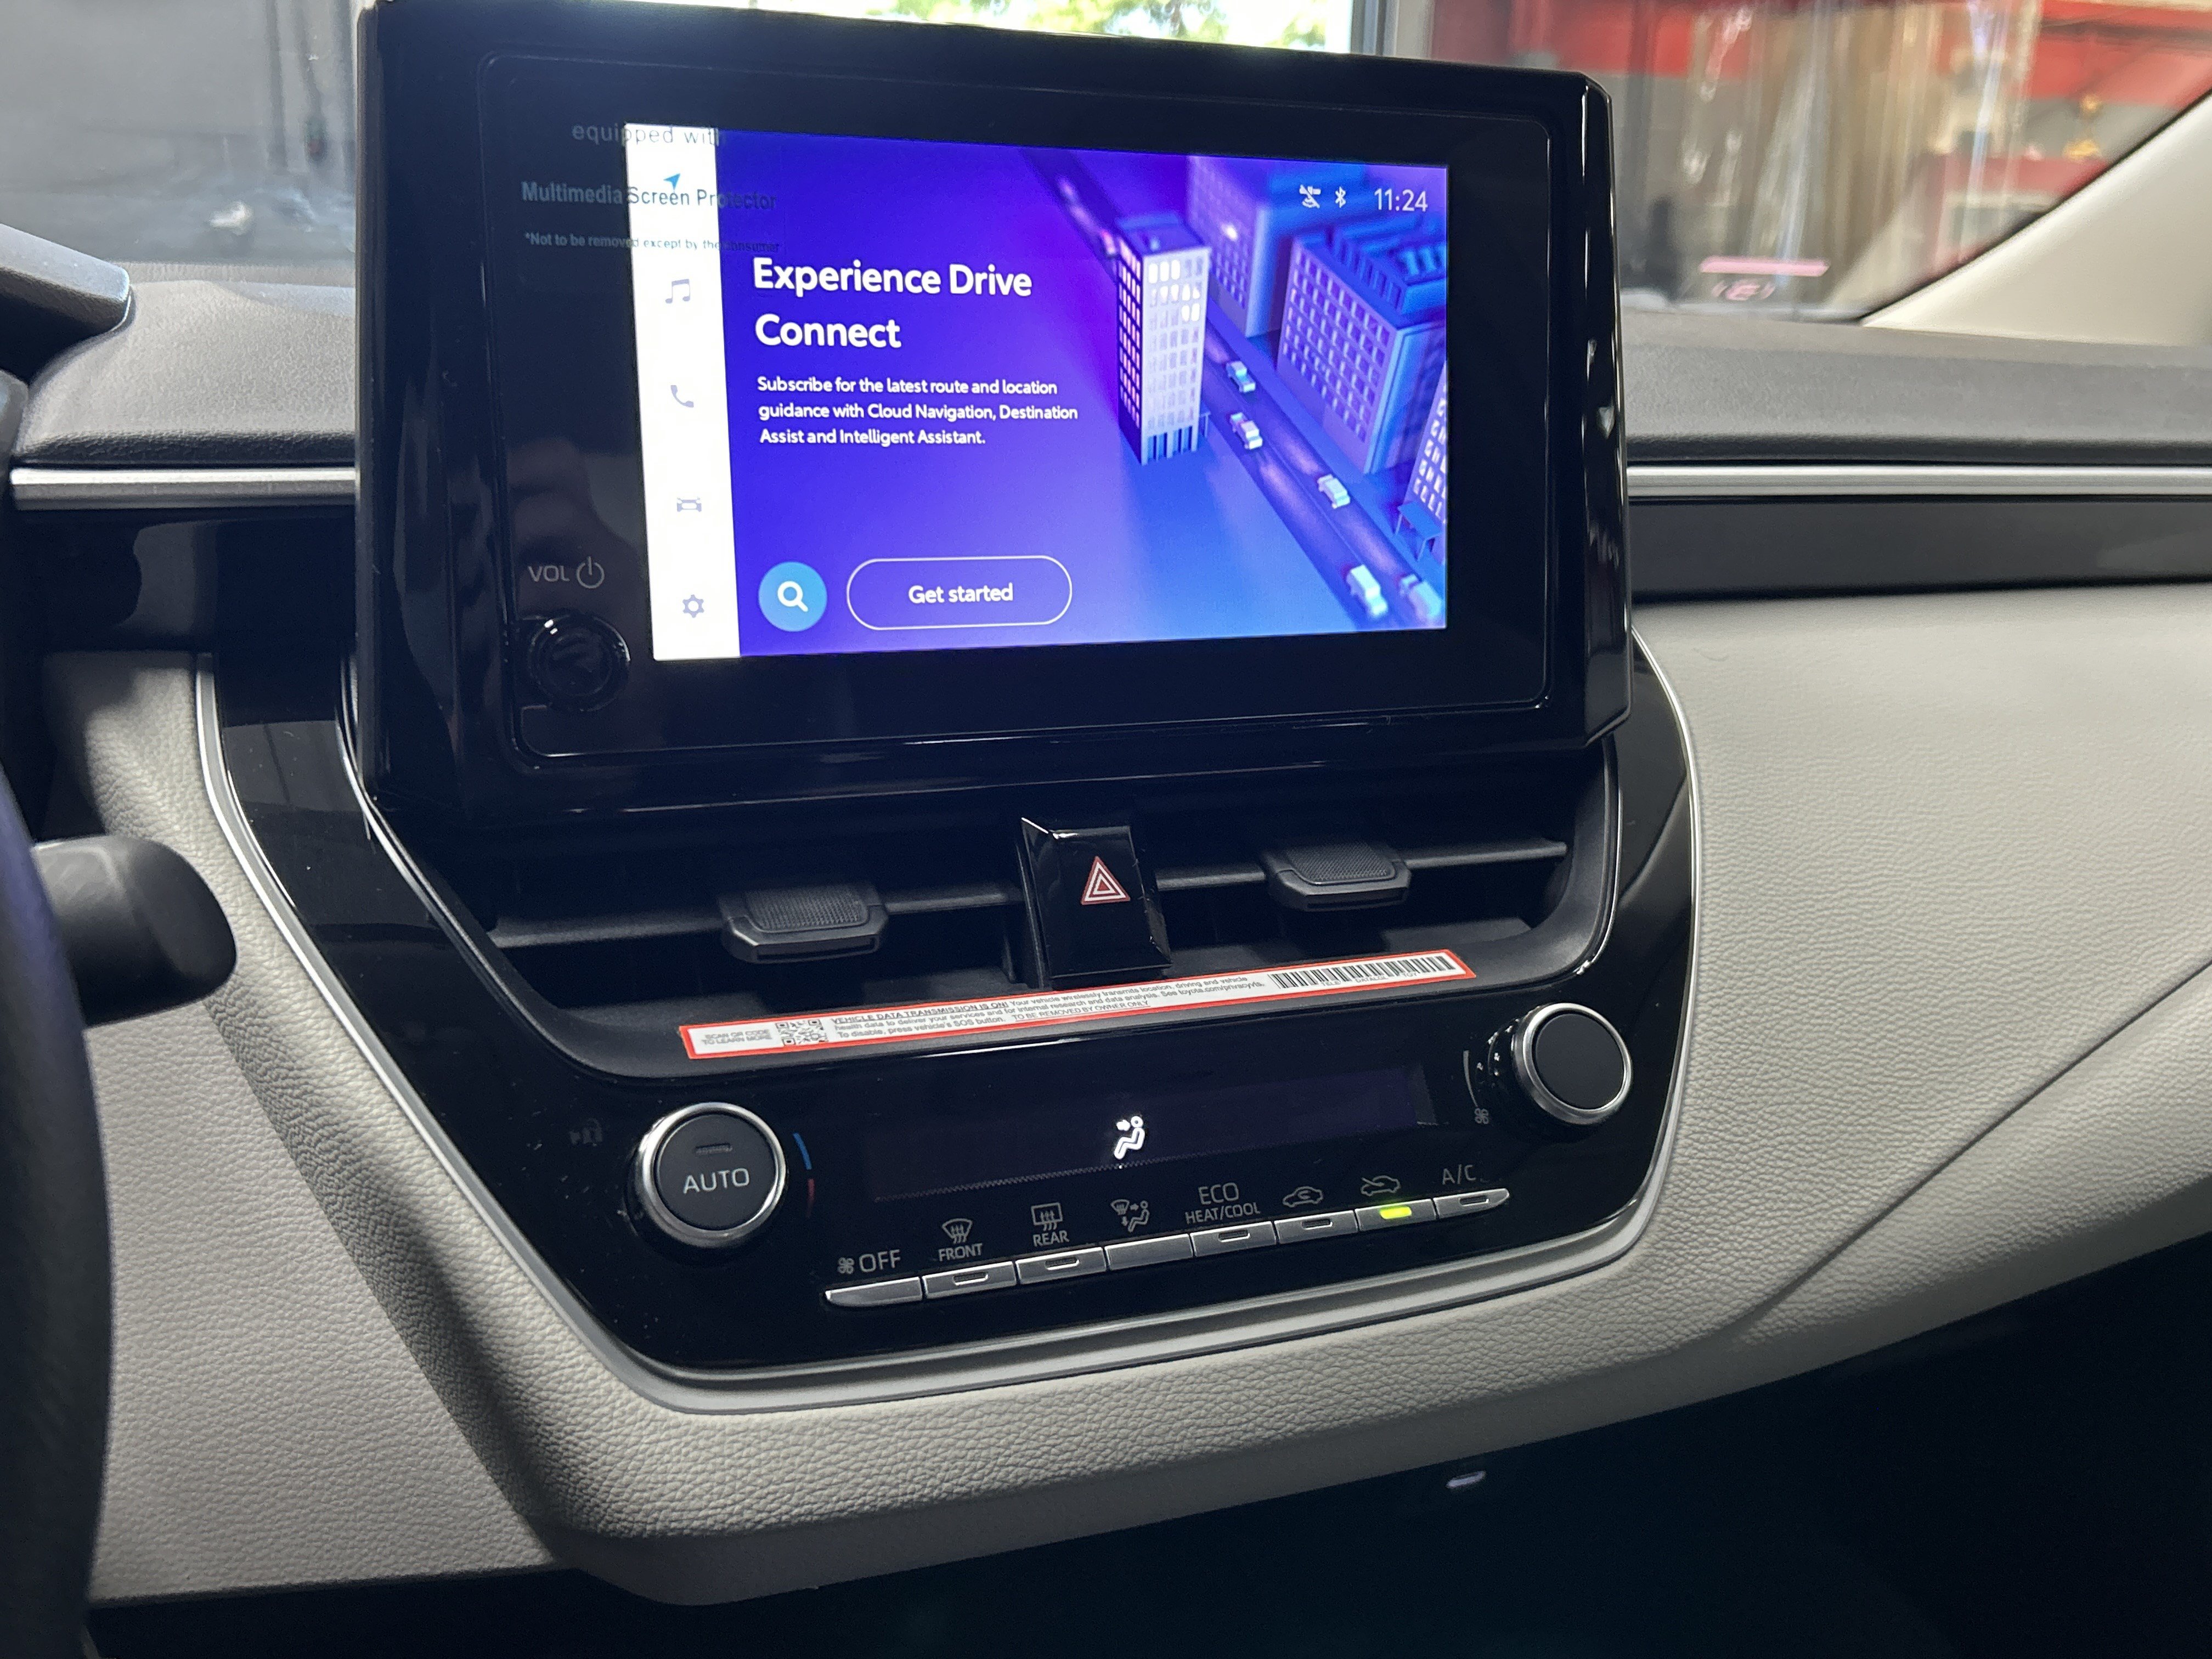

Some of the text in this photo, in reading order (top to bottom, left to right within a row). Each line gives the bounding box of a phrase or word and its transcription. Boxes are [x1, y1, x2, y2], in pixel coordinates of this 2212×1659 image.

[571, 123, 722, 146] equipped with
[521, 181, 777, 210] Multimedia Screen Protector
[1374, 188, 1428, 212] 11:24
[555, 233, 568, 246] to
[569, 233, 585, 246] be
[588, 235, 639, 247] removed
[644, 239, 681, 249] except
[686, 239, 697, 250] by
[703, 239, 720, 250] the
[753, 257, 1033, 297] Experience Drive
[754, 313, 902, 348] Connect
[757, 375, 1058, 394] Subscribe for the latest route and location
[758, 402, 1078, 422] guidance with Cloud Navigation, Destination
[760, 428, 986, 447] Assist and Intelligent Assistant.
[528, 565, 571, 582] VOL
[908, 582, 1014, 604] Get started
[831, 1015, 875, 1024] VEHICLE
[877, 1012, 904, 1021] DATA
[904, 1004, 978, 1017] TRANSMISSION
[1061, 992, 1101, 1001] wirelessly
[887, 1026, 913, 1035] press
[914, 1022, 952, 1031] vehicle's
[975, 1017, 1006, 1025] button.
[1039, 1008, 1081, 1018] REMOVED
[1094, 1002, 1126, 1011] OWNER
[950, 1012, 985, 1020] services
[1017, 1004, 1049, 1012] internal
[1050, 1000, 1086, 1009] research
[682, 1167, 750, 1194] AUTO
[1442, 1164, 1477, 1186] A/C
[1198, 1182, 1239, 1205] ECO
[1184, 1201, 1261, 1224] HEAT/COOL
[1032, 1229, 1070, 1248] REAR
[859, 1249, 901, 1273] OFF
[938, 1242, 984, 1262] FRONT
